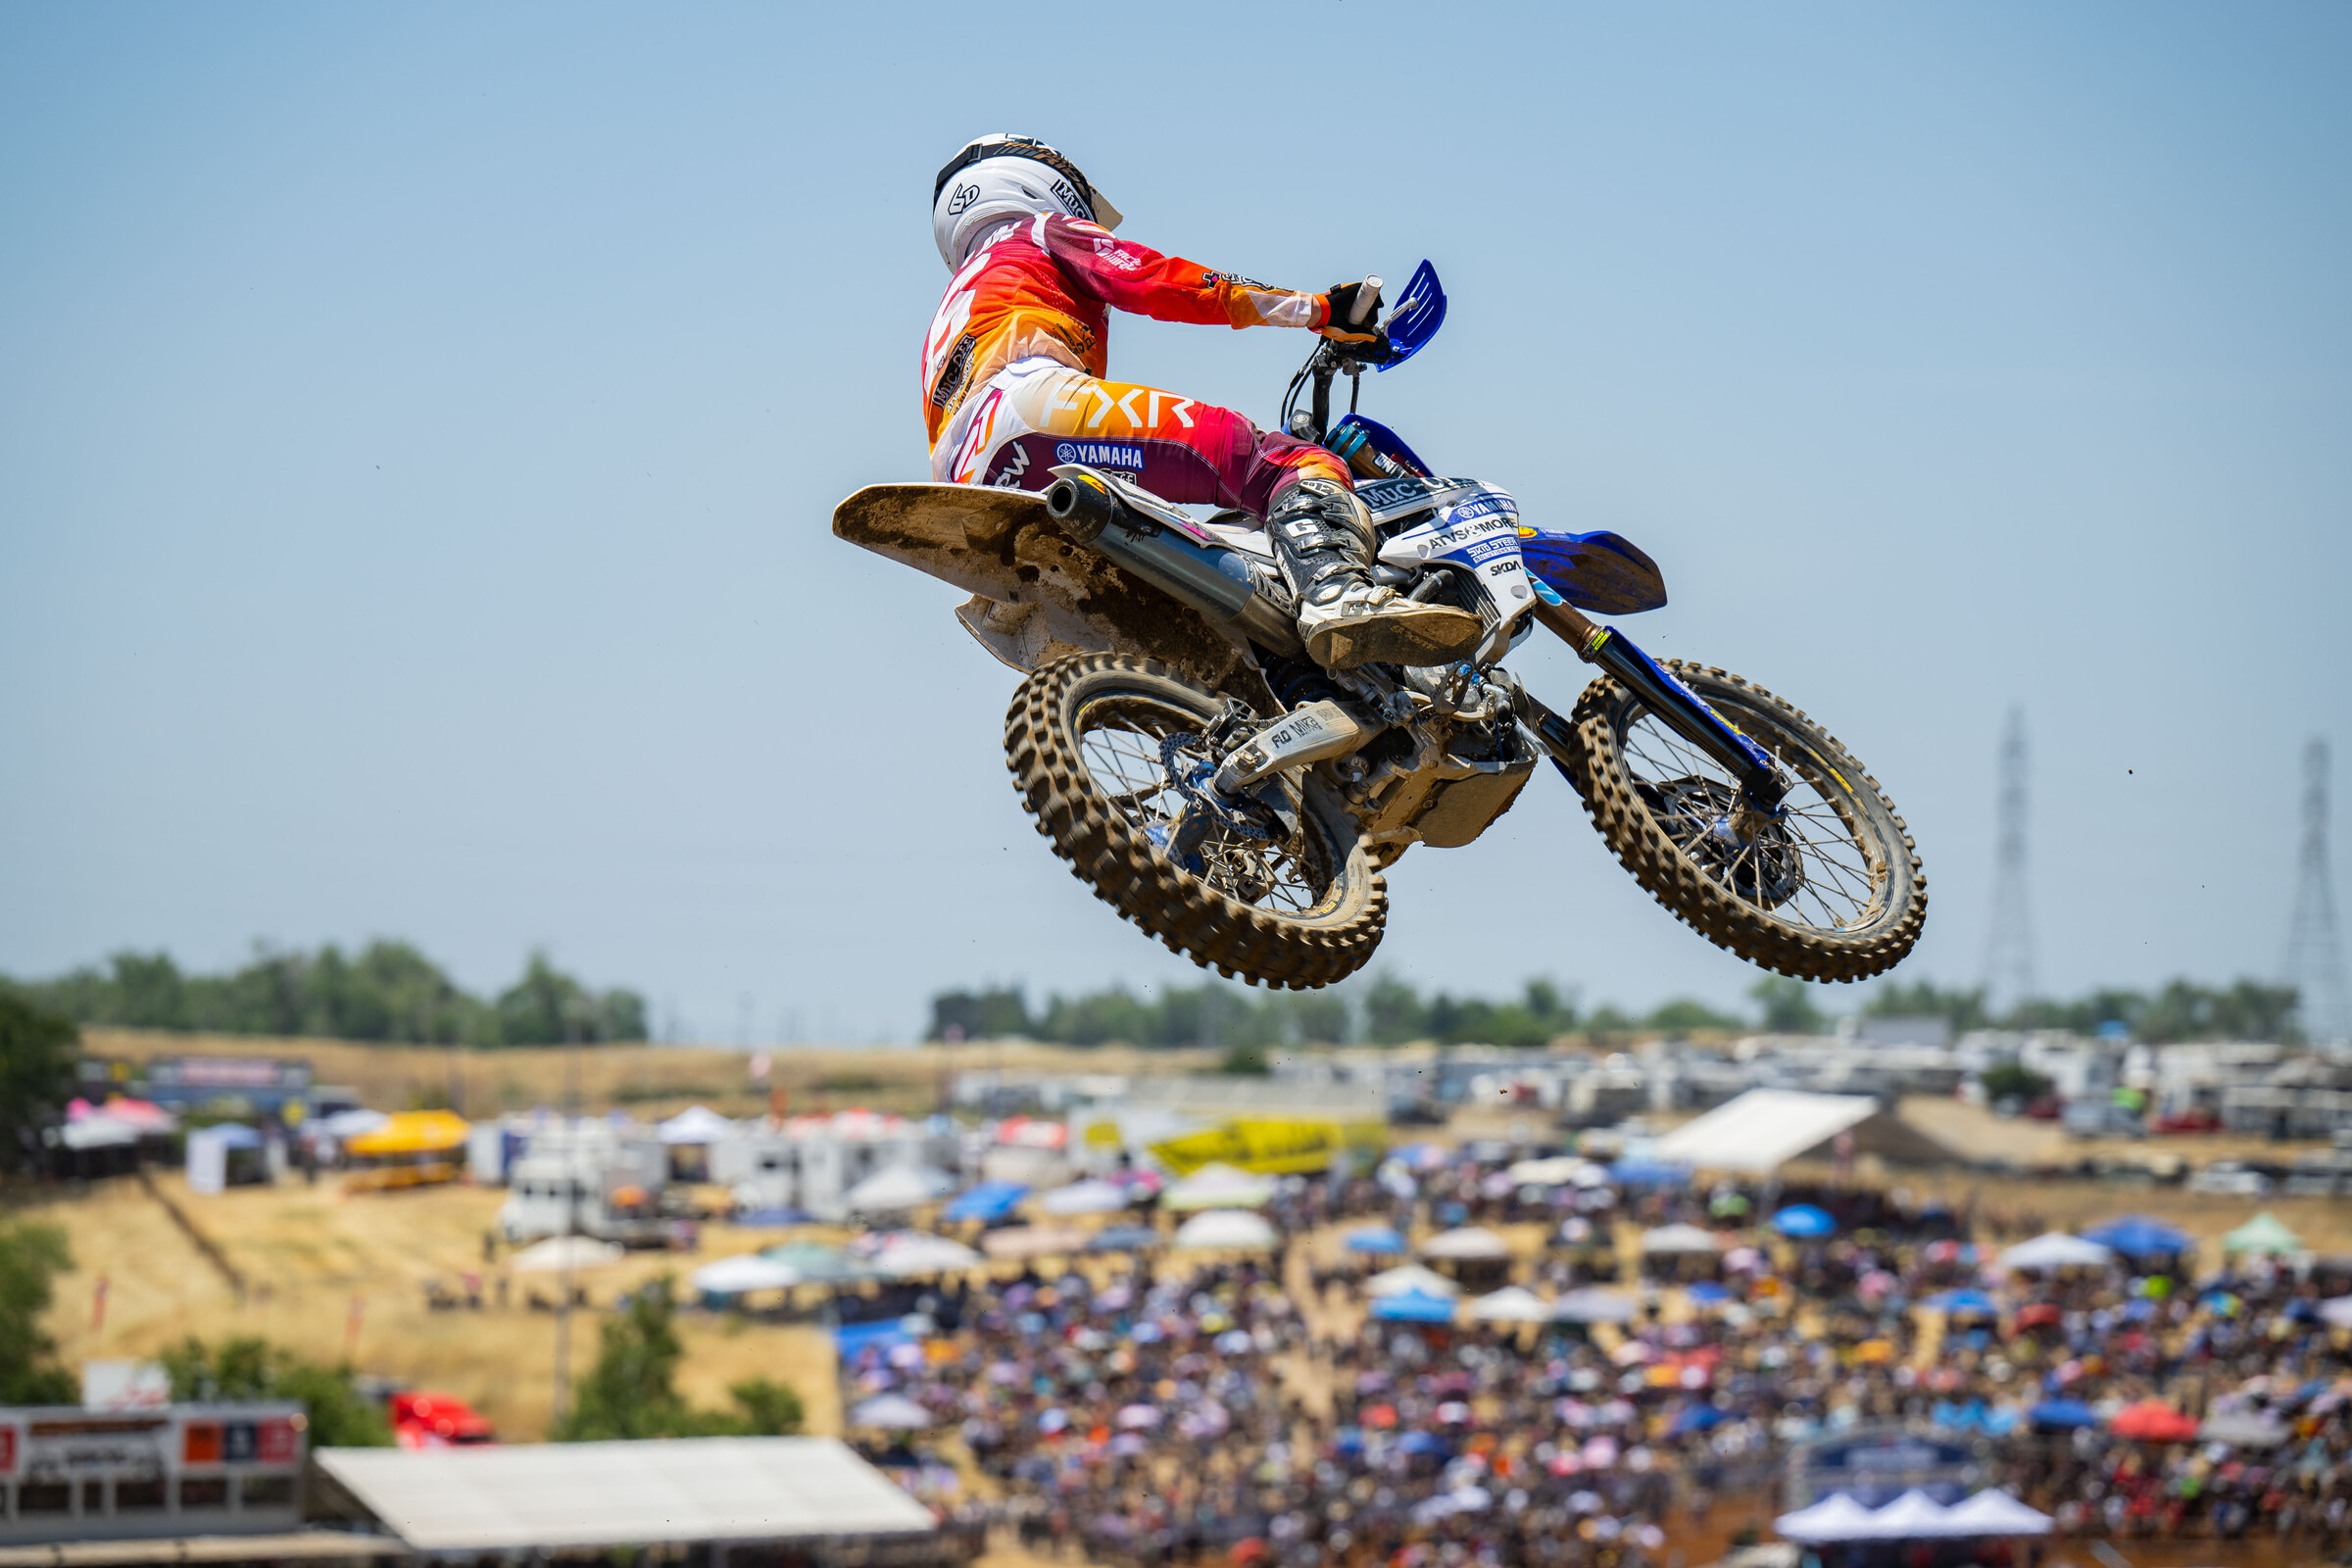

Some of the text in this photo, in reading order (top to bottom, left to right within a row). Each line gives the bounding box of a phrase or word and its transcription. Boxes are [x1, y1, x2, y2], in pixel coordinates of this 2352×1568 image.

[948, 182, 981, 216] 6D
[1039, 382, 1195, 428] FXR
[1077, 444, 1143, 469] YAMAHA
[1471, 498, 1515, 515] YAMAHA
[1466, 541, 1491, 558] SKID
